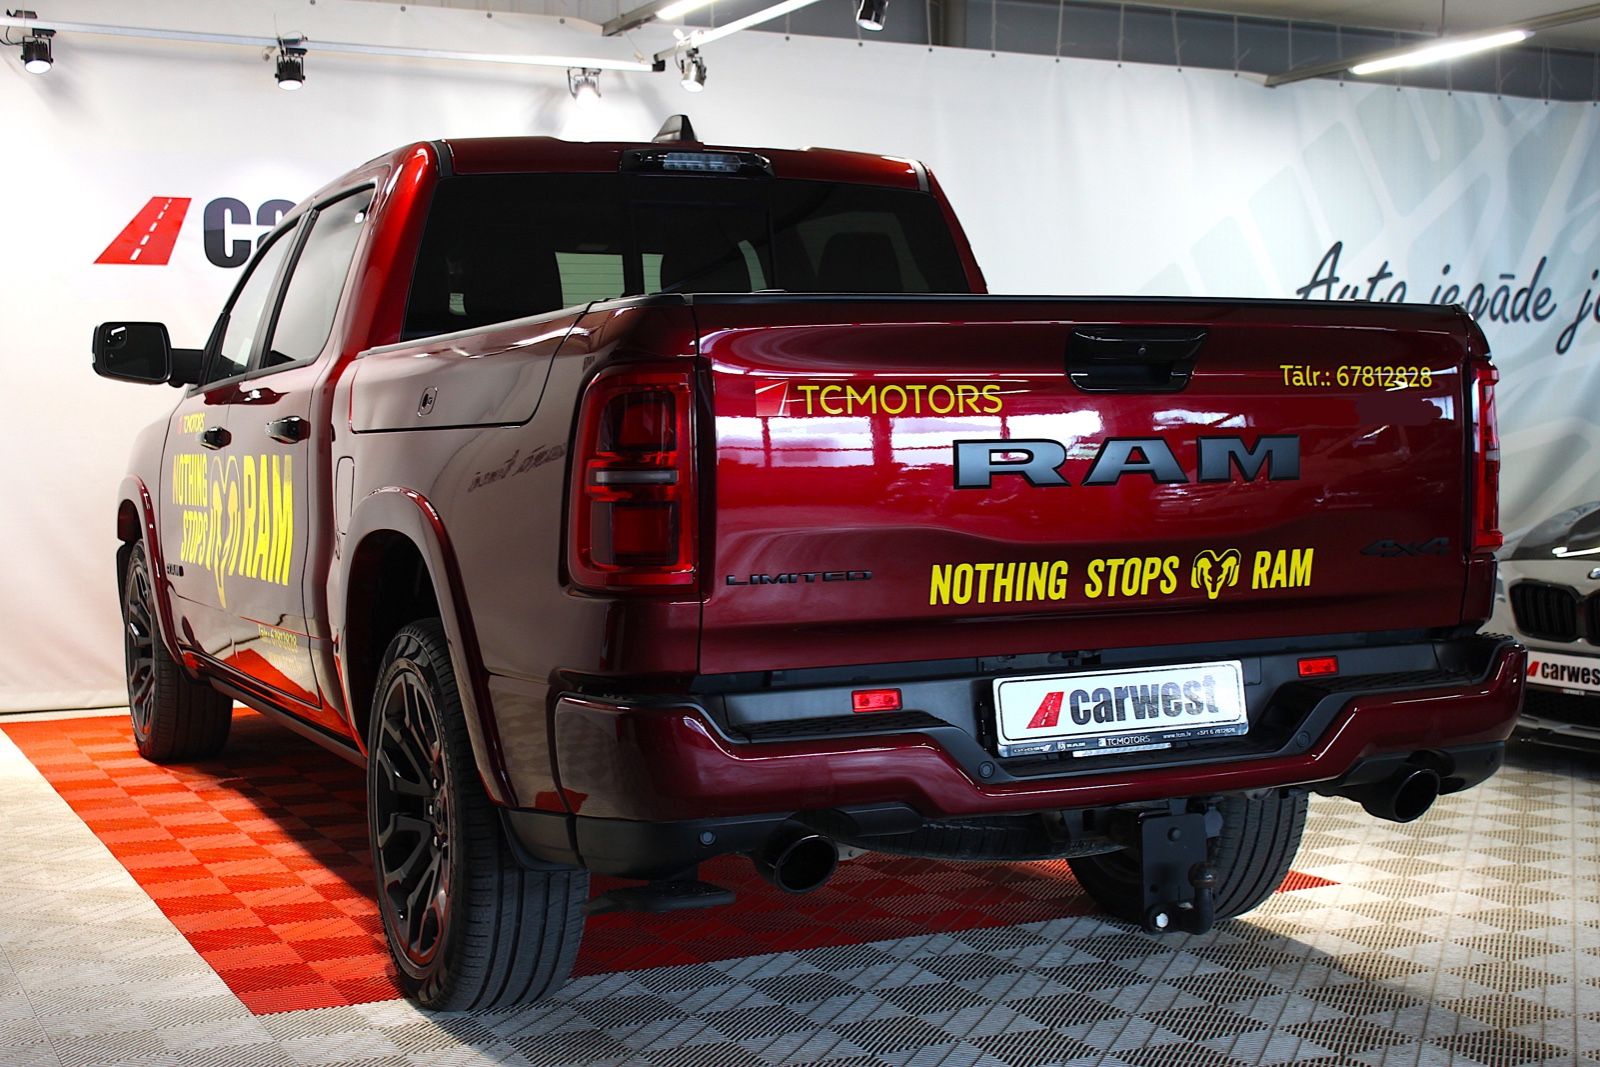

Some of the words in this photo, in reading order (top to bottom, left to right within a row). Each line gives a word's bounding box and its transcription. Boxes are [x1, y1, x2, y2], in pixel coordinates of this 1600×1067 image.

[1556, 269, 1600, 355] j
[797, 384, 1003, 415] TCMOTORS
[1336, 365, 1433, 388] 67812828
[172, 453, 208, 507] NOTHING
[953, 434, 1300, 490] RAM
[180, 509, 209, 567] STOPS
[238, 454, 293, 586] RAM
[726, 569, 873, 586] LIMITED
[929, 560, 1069, 606] NOTHING
[1084, 555, 1179, 600] STOPS
[1251, 548, 1314, 590] RAM
[1069, 675, 1220, 726] carwest
[1106, 735, 1151, 746] TCMOTORS
